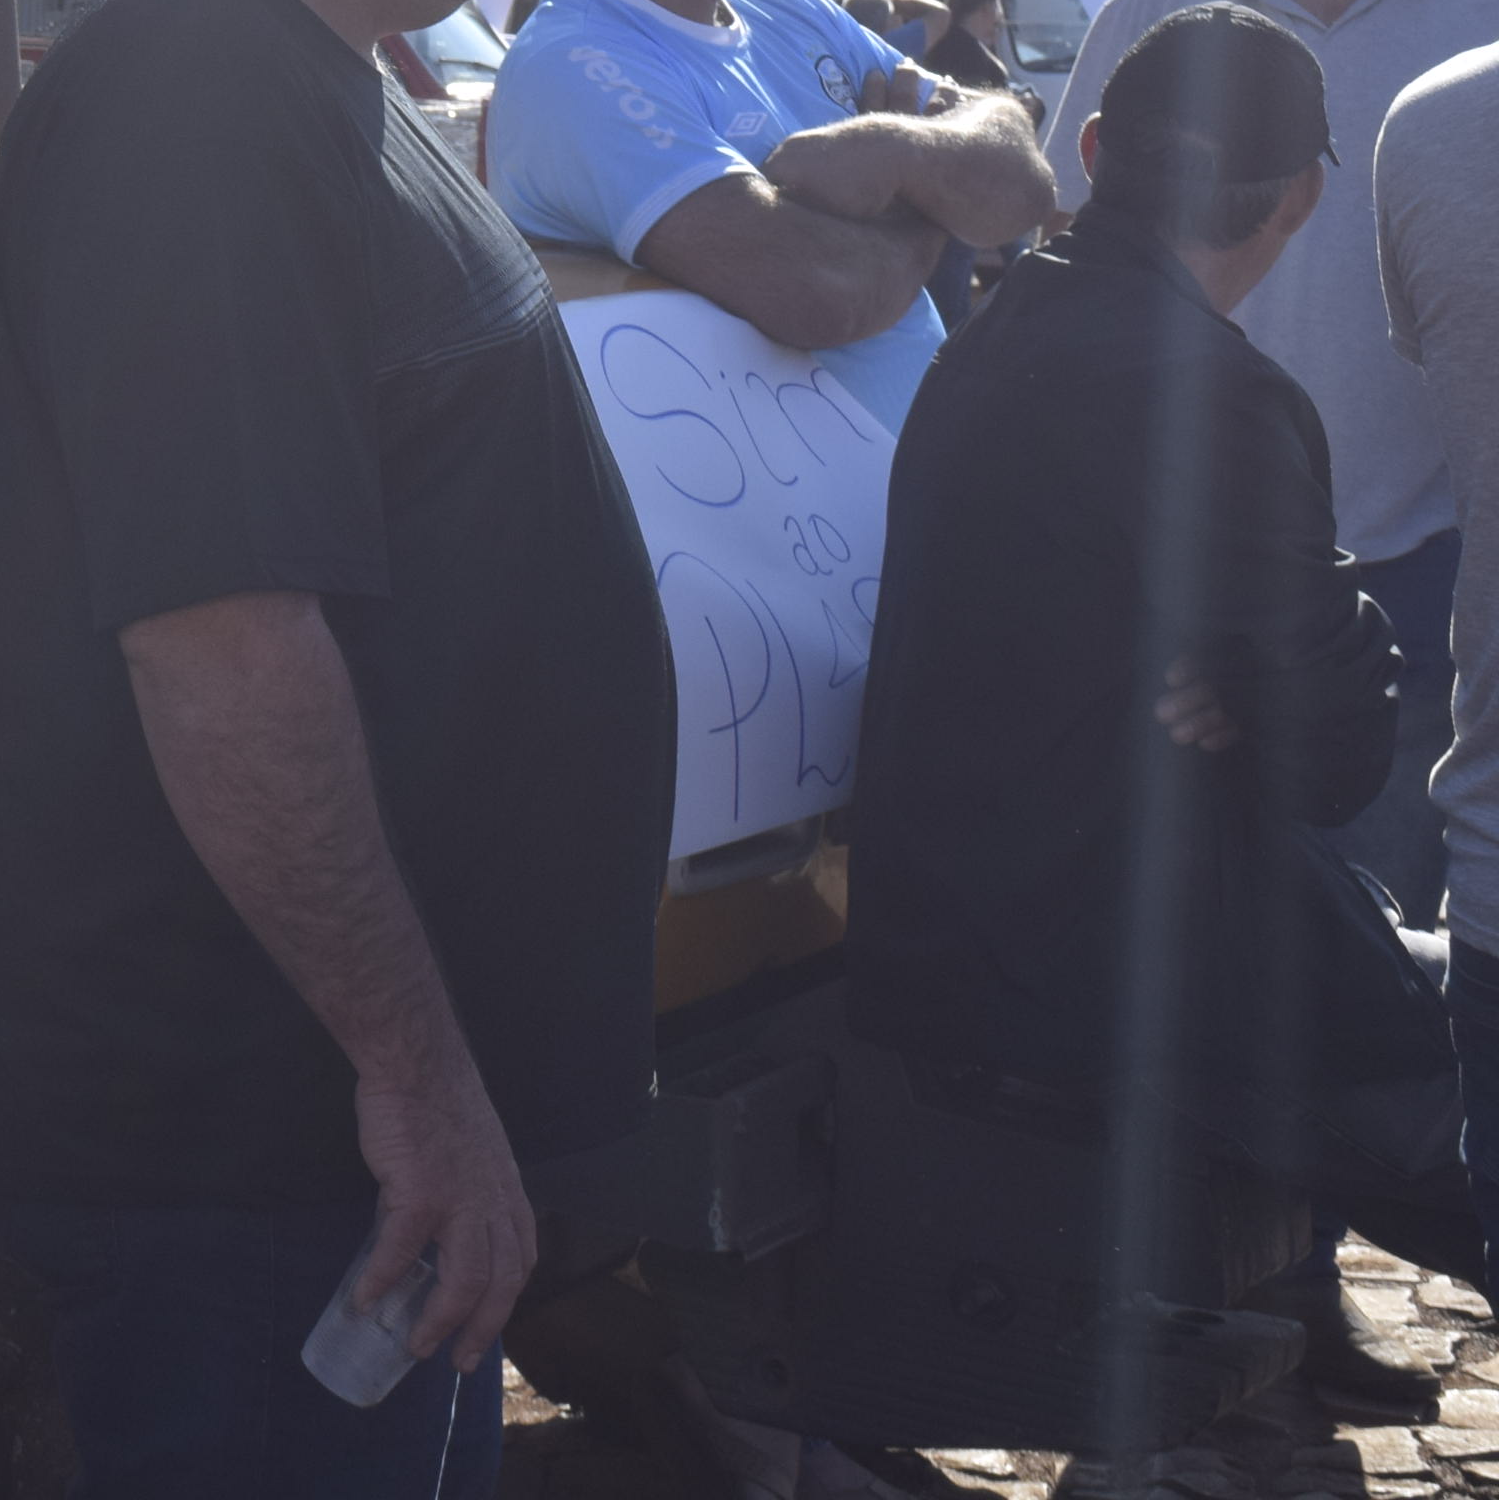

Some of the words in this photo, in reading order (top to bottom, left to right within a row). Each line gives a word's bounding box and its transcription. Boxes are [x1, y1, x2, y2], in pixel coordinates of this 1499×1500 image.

[599, 323, 873, 507] Sim
[783, 513, 851, 576] ao
[657, 550, 850, 822] PL
